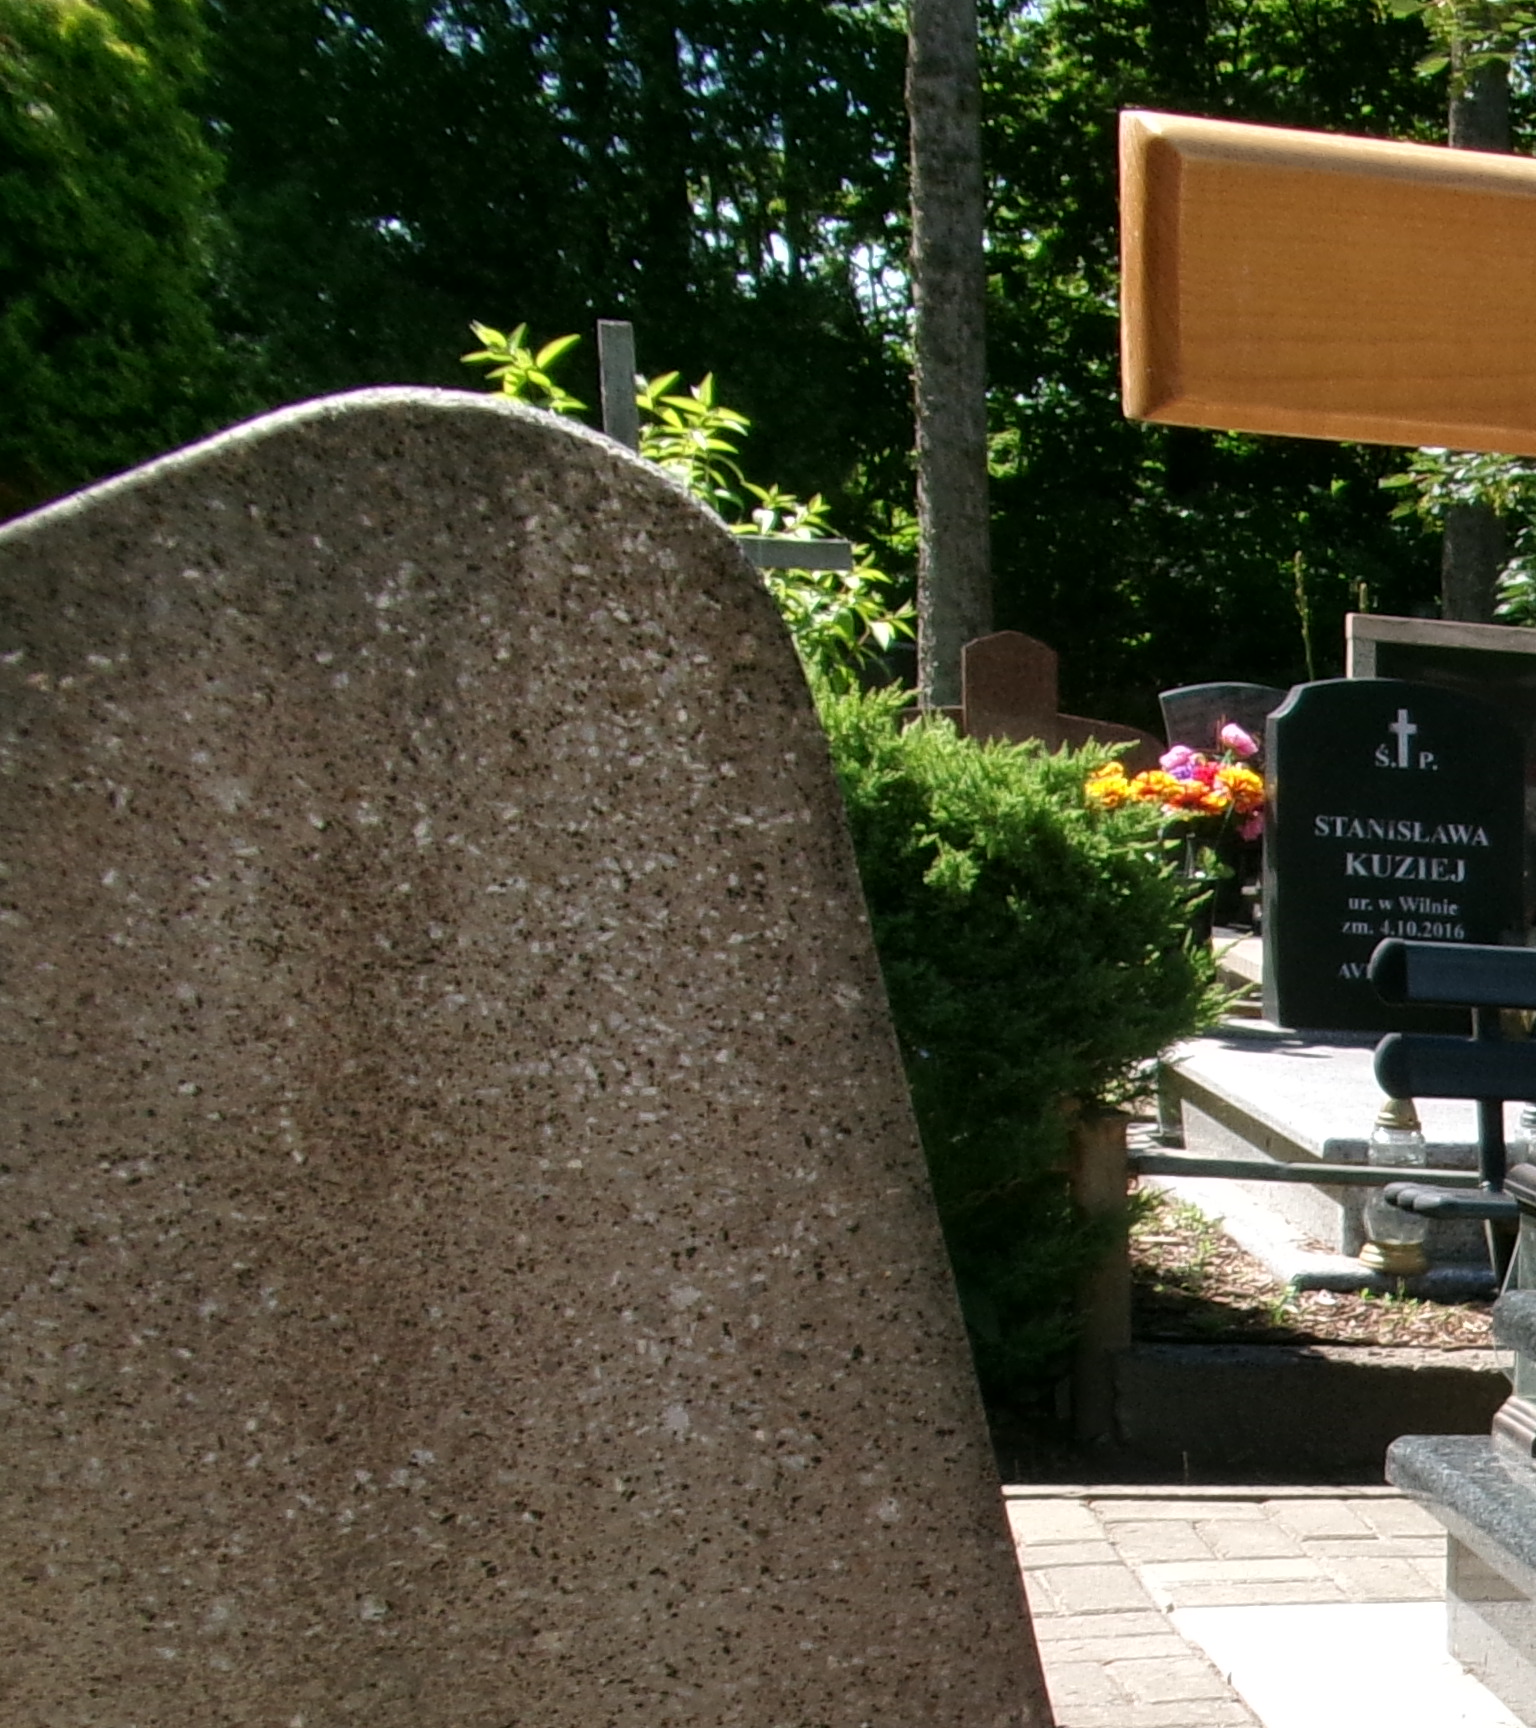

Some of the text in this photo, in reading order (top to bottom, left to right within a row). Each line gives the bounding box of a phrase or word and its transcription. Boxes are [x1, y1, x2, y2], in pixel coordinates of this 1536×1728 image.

[1313, 813, 1490, 847] STANISŁAWA
[1344, 851, 1467, 883] KUZIEJ
[1348, 896, 1459, 916] ur. w Wilnie
[1341, 918, 1466, 940] zm. 4.10.2016
